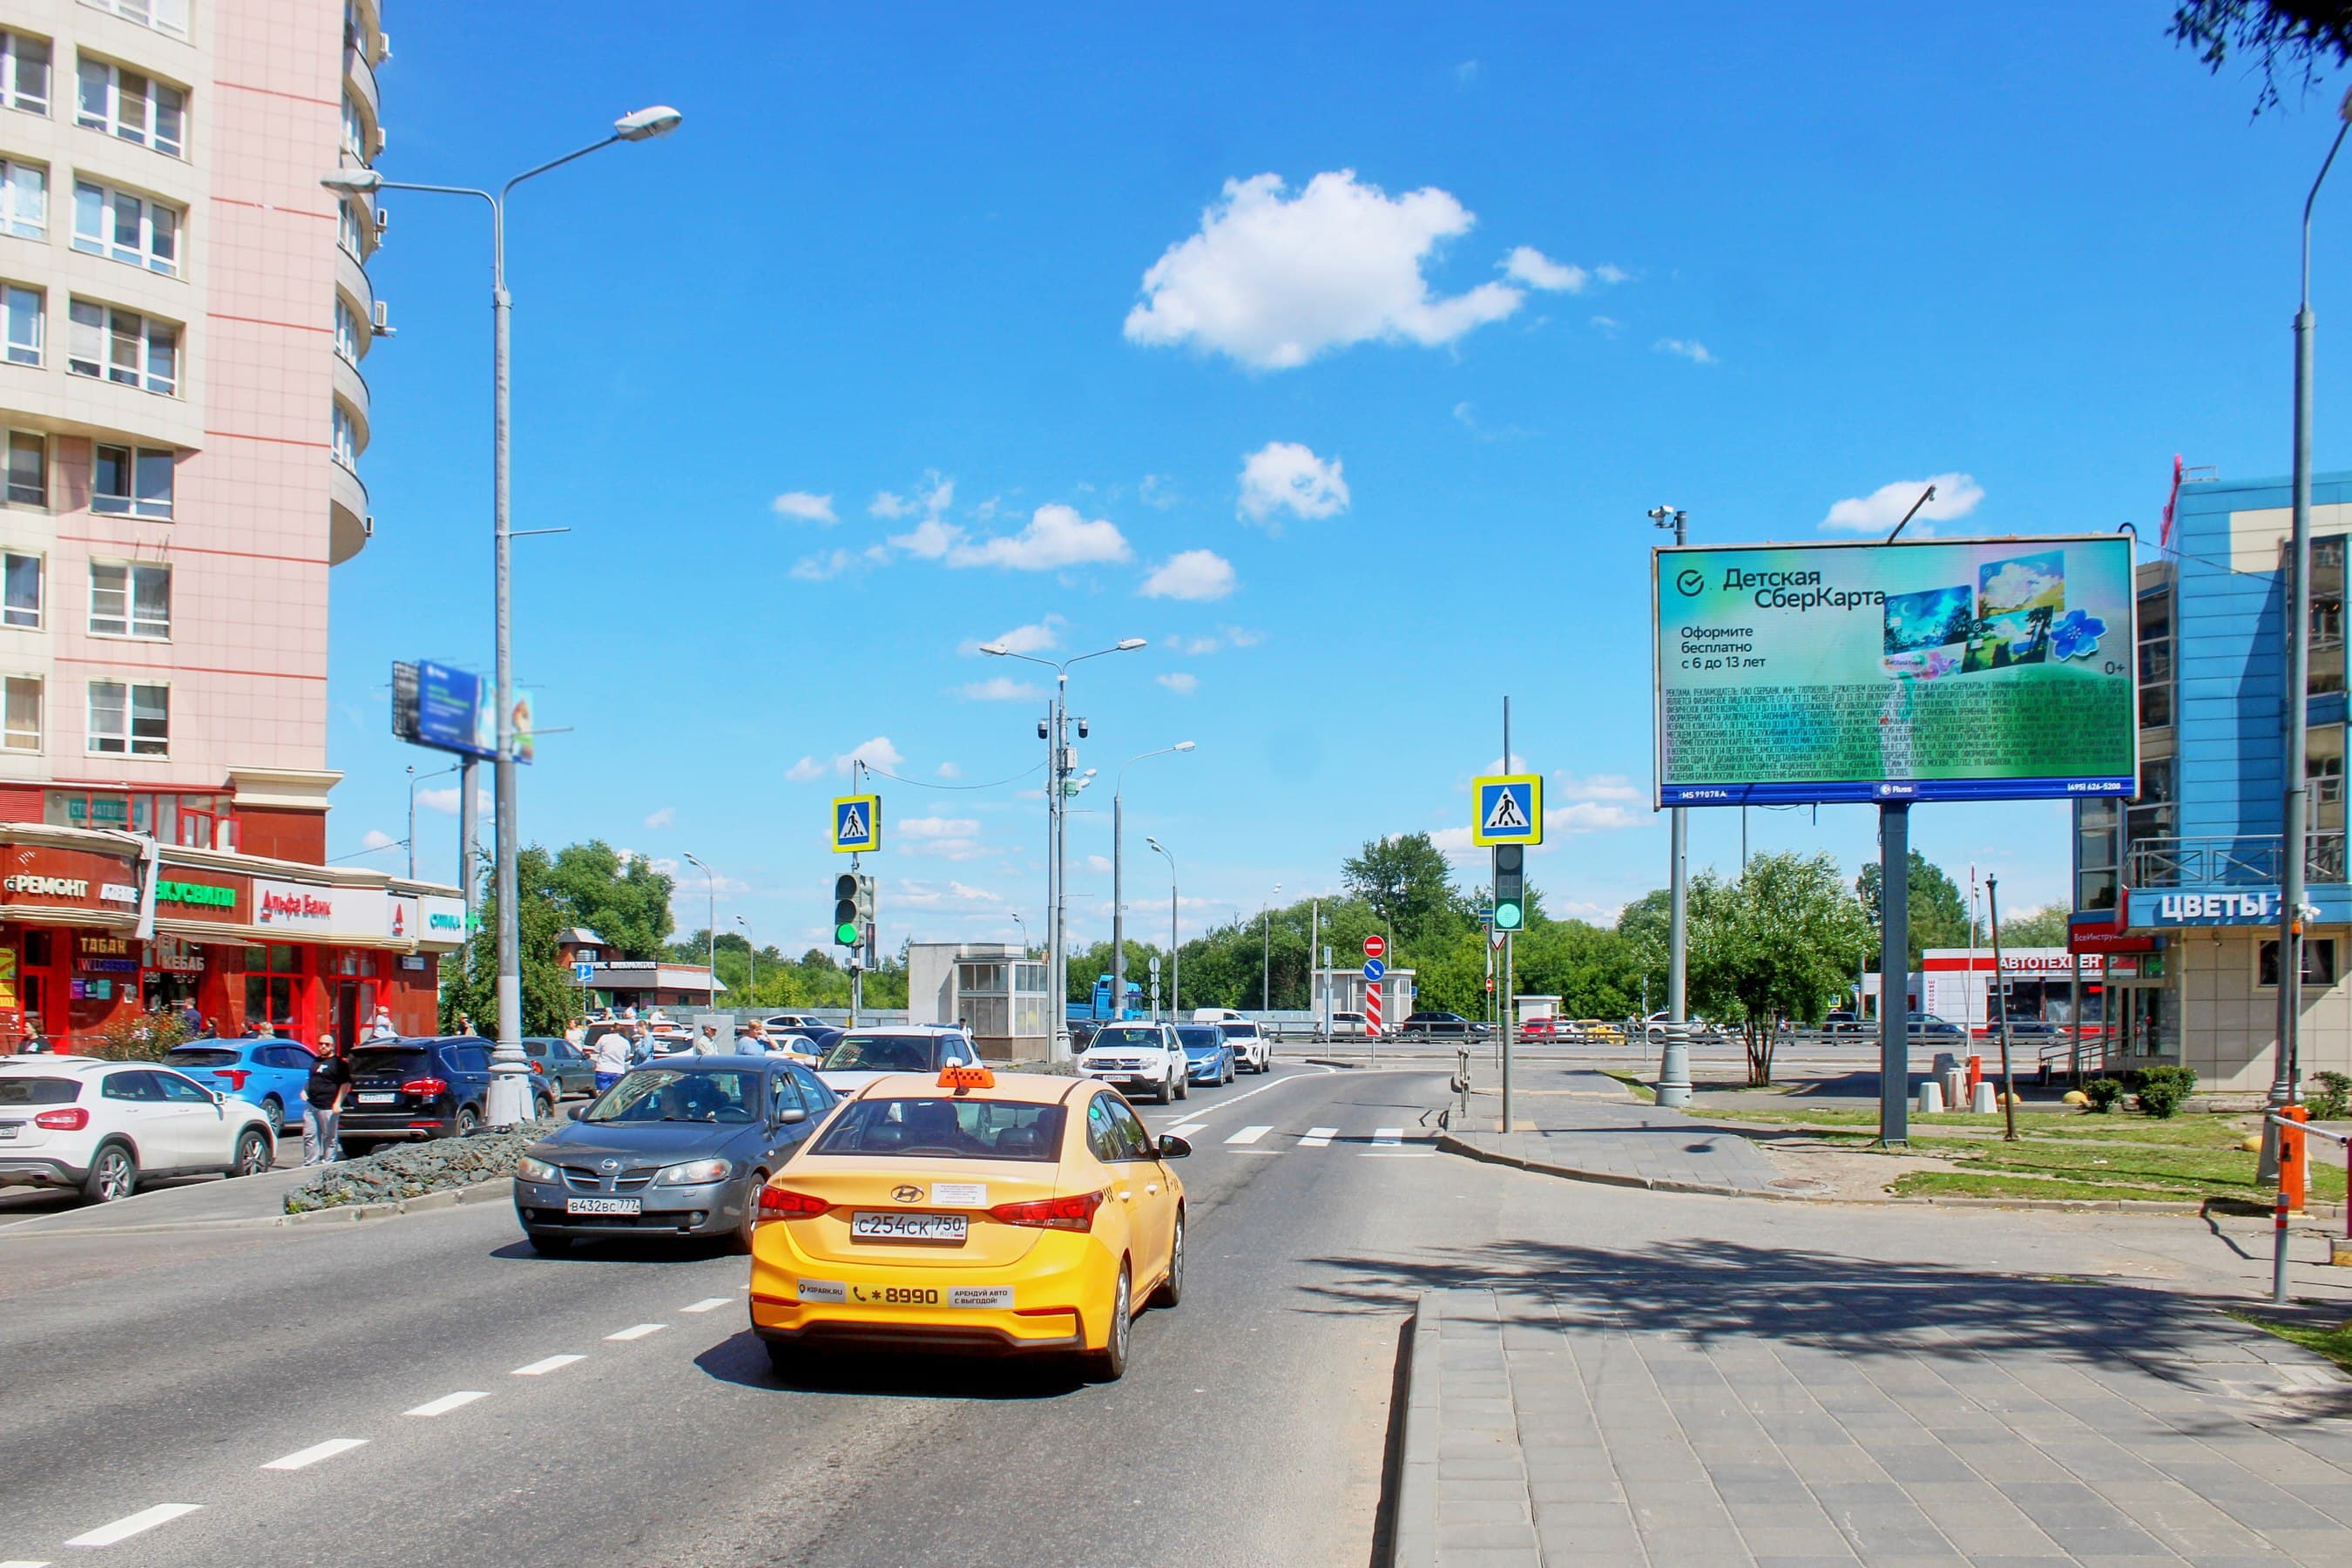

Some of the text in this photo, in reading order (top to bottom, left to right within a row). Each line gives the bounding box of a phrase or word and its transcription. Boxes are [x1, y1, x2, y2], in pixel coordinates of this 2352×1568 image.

[1723, 568, 1821, 591] Детская
[1754, 587, 1886, 612] СберКарта
[1681, 625, 1754, 640] Оформите
[1681, 641, 1752, 653] бесплатно
[1681, 656, 1766, 671] с 6 до 13 лет
[2105, 661, 2126, 675] 0+
[1892, 785, 1912, 794] Russ
[2067, 782, 2086, 791] (495)
[16, 874, 89, 897] РЕМОНТ
[2160, 893, 2268, 923] ЦВЕТЫ
[80, 937, 128, 955] ТАБАК
[161, 955, 206, 971] КЕБАБ
[571, 1200, 636, 1212] В432ВС 777
[858, 1215, 962, 1235] С254СК 750
[807, 1286, 842, 1295] KIPARK.RU
